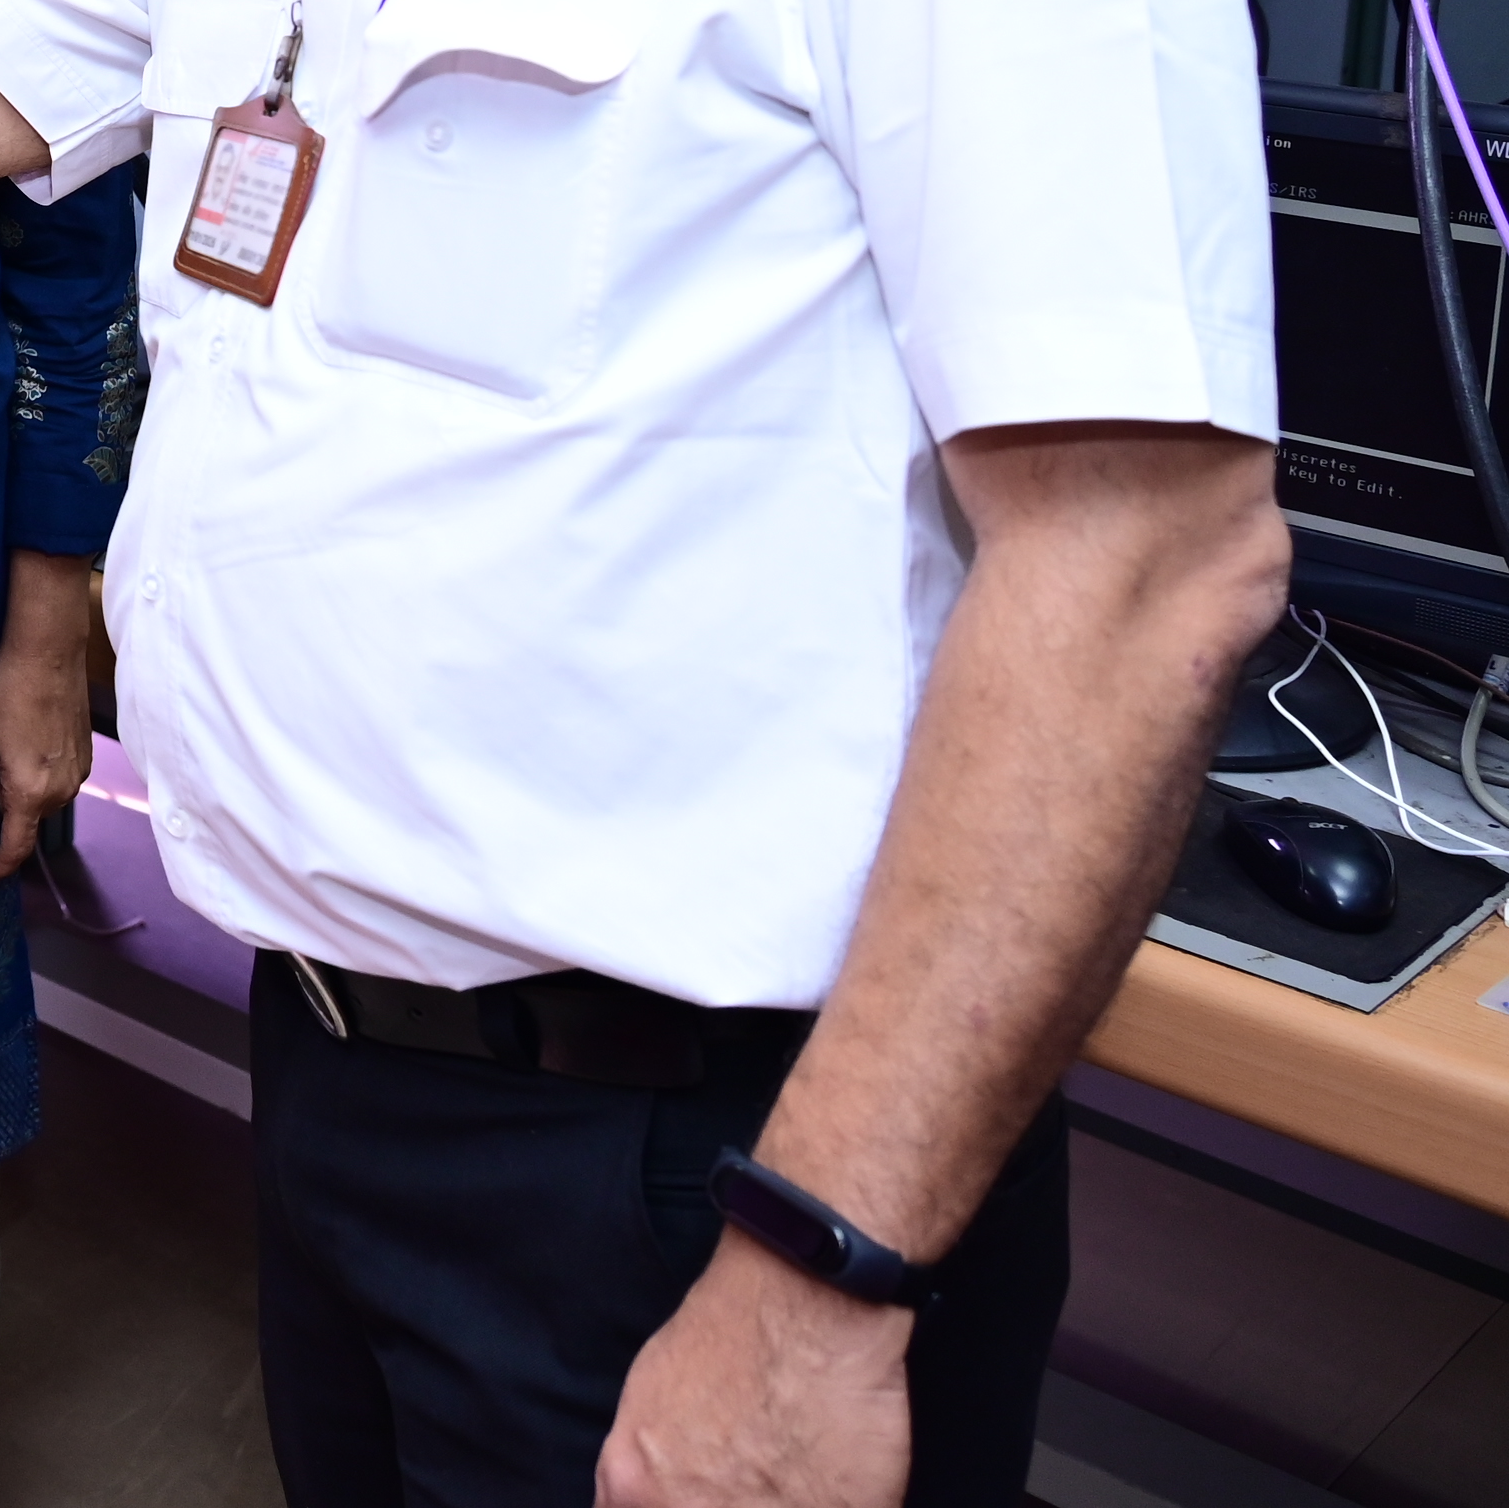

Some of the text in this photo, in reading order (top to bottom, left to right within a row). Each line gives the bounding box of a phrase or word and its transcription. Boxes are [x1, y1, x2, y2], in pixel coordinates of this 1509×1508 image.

[1289, 465, 1403, 499] Key to Edit.
[1308, 822, 1348, 830] acer
